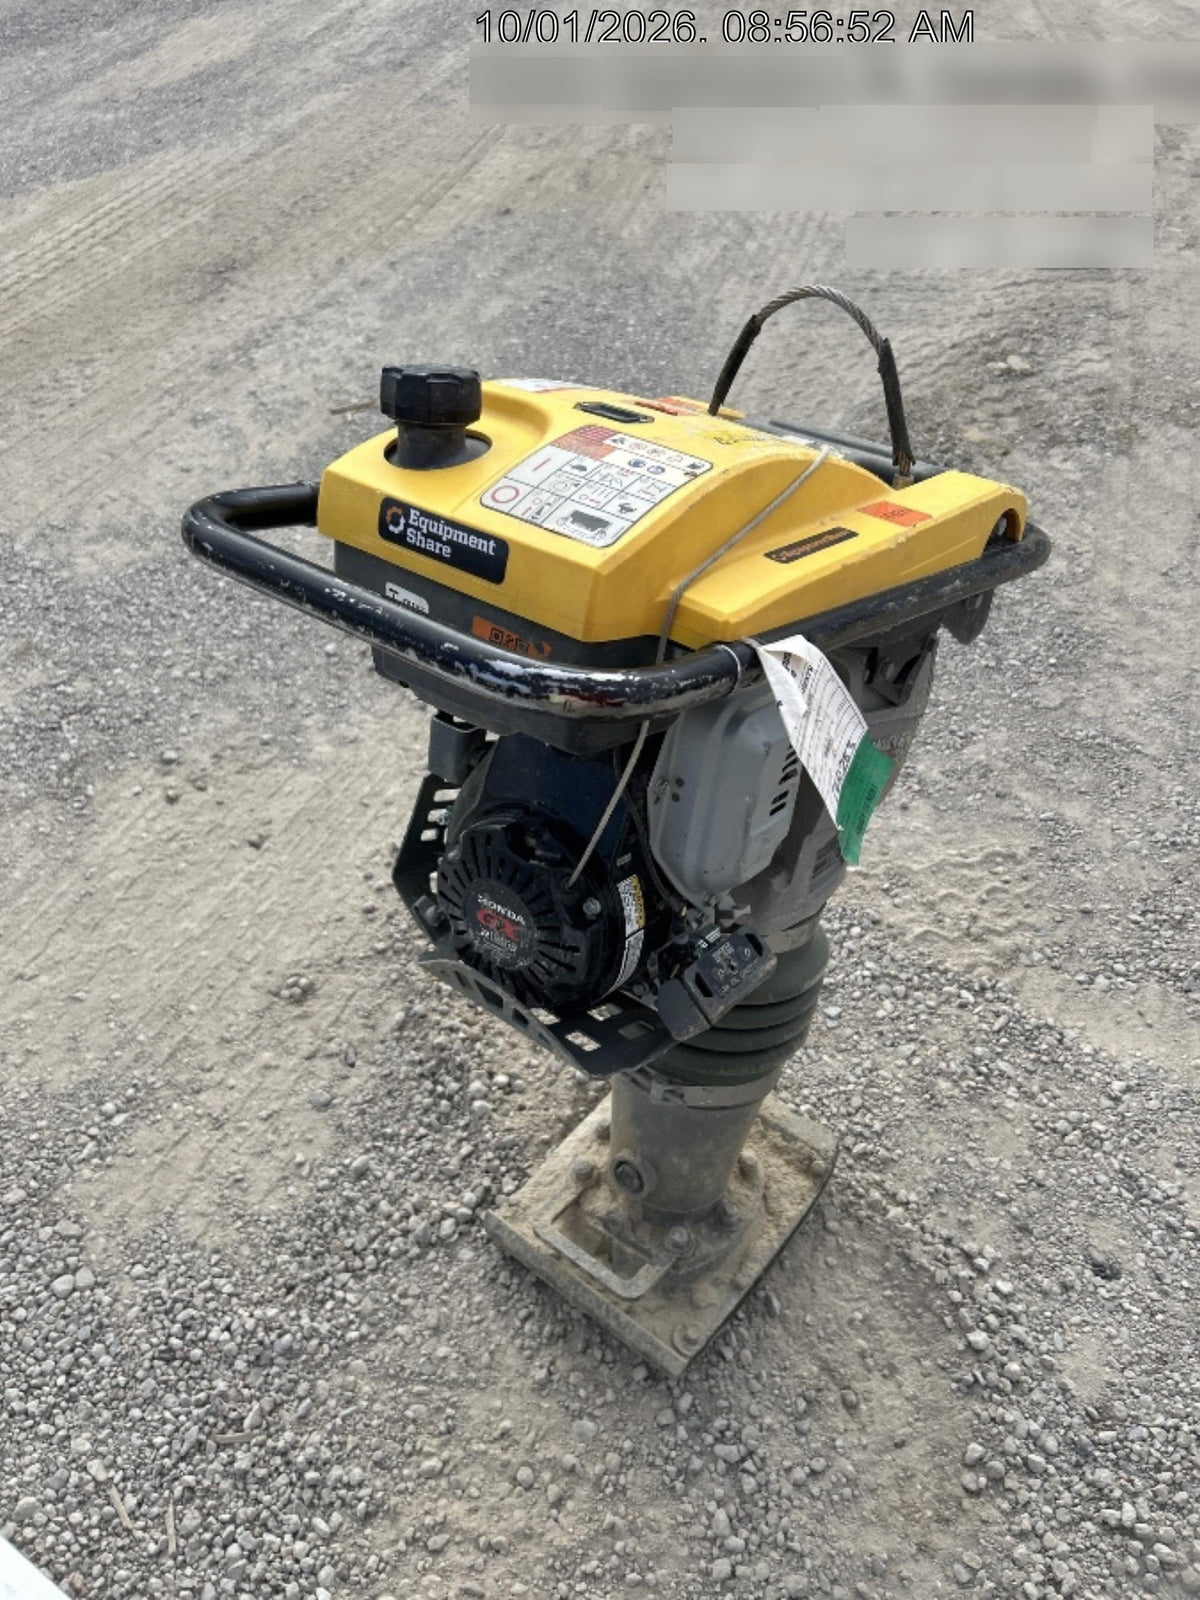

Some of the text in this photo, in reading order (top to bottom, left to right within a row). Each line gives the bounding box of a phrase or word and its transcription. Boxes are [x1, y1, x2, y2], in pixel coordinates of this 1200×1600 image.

[406, 527, 451, 558] Share
[408, 508, 497, 556] Equipment
[478, 894, 525, 926] HONDA
[478, 909, 522, 942] GX
